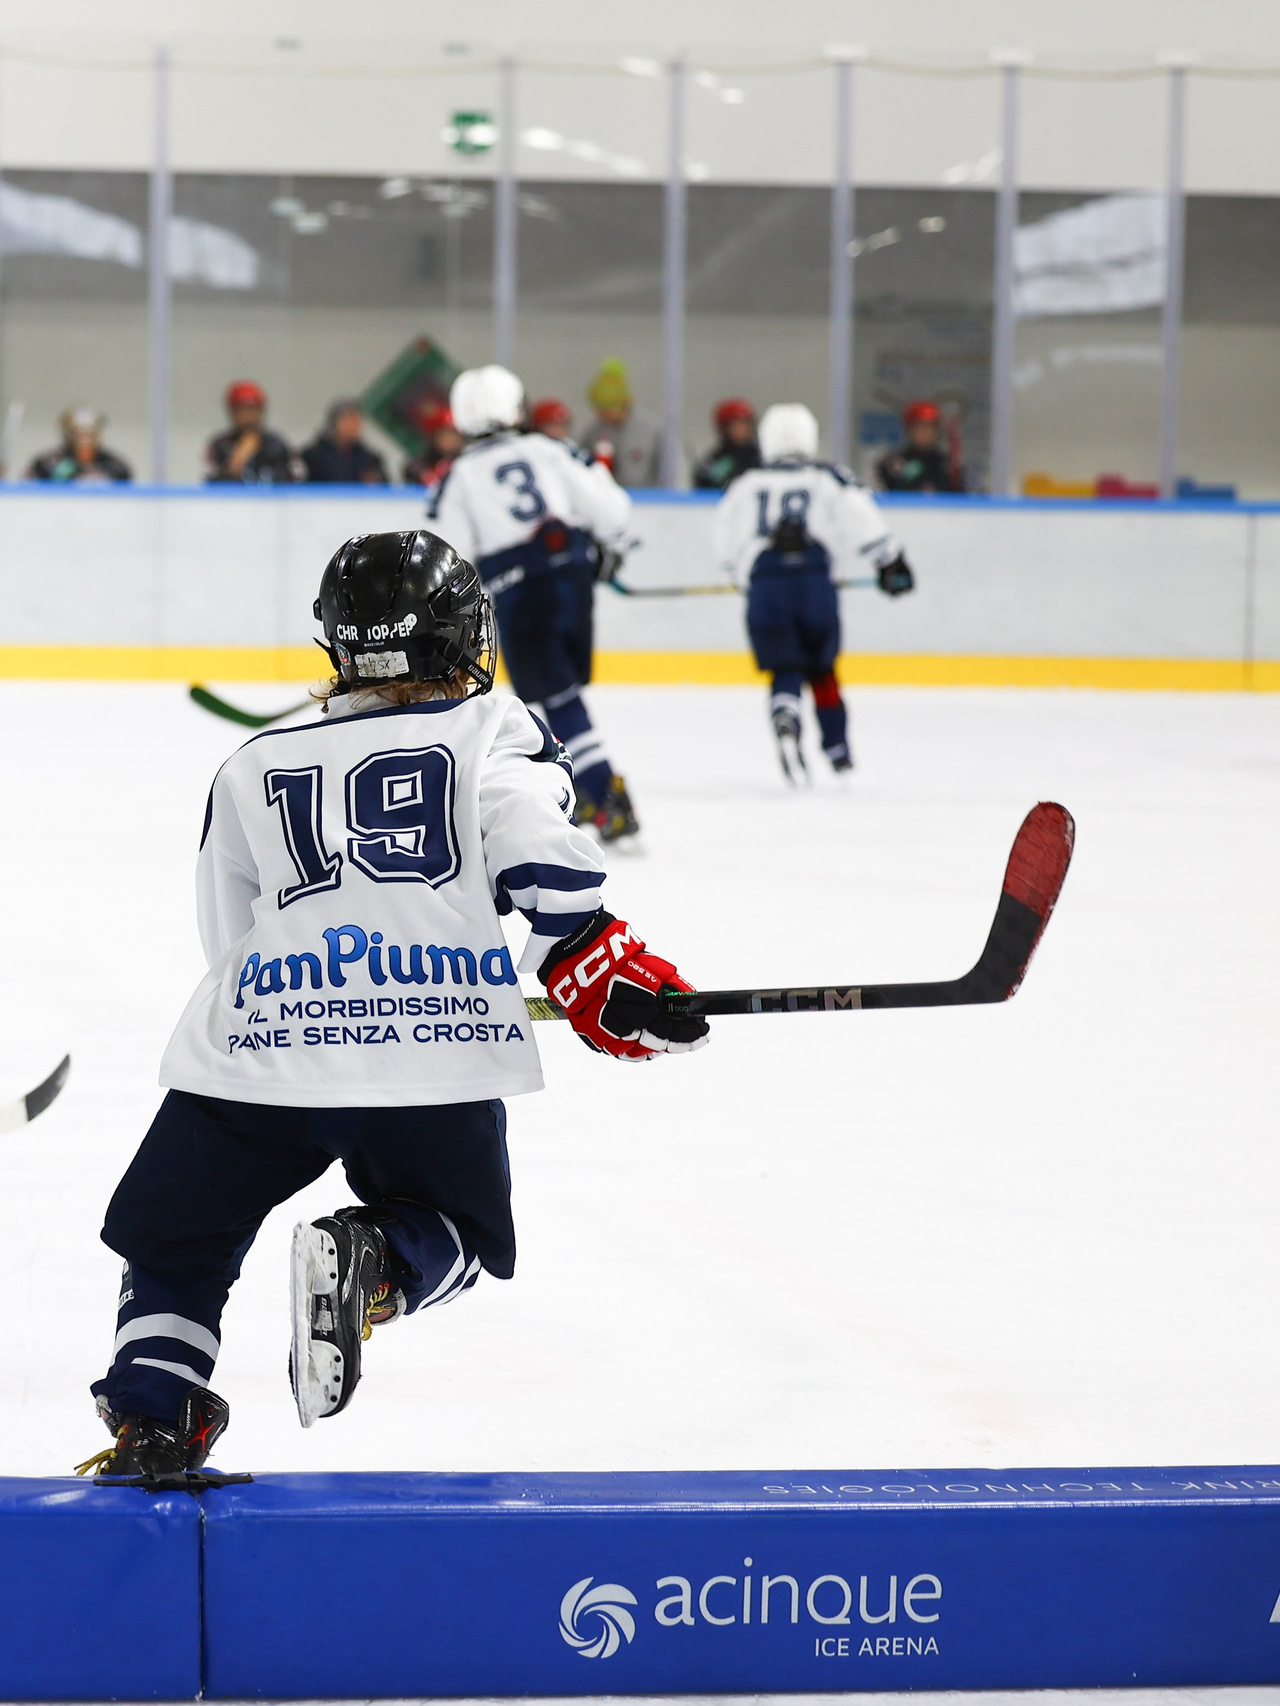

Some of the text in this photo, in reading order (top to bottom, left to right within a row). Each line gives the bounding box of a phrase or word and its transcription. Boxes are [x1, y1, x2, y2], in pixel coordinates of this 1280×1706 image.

[495, 461, 548, 521] 3
[263, 743, 462, 910] 19
[234, 924, 518, 1009] PanPiuma
[552, 923, 643, 1009] CCM
[247, 996, 489, 1025] IL MORBIDISSIMO
[750, 987, 864, 1014] CCM
[228, 1023, 525, 1054] PANE SENZA CROSTA
[762, 1481, 1154, 1495] TECHNOLOGIES
[654, 1556, 943, 1626] acinque
[814, 1636, 940, 1657] ICE ARENA
